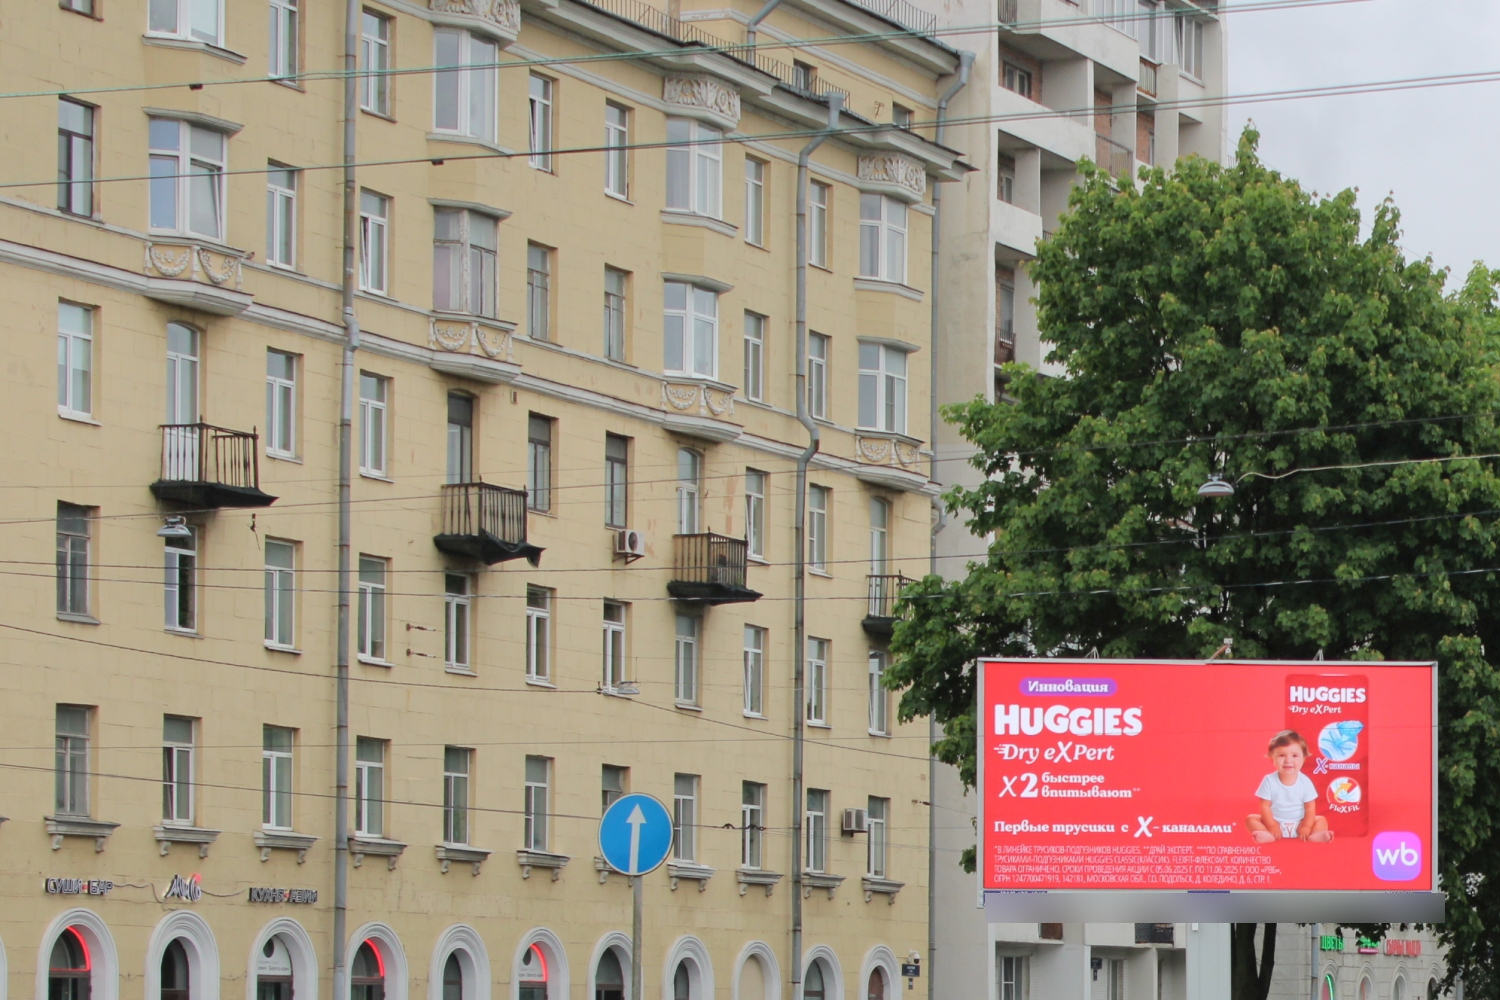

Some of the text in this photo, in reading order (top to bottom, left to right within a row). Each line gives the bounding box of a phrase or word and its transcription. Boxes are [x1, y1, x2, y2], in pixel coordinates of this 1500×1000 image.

[1028, 679, 1109, 693] Инновация
[1290, 686, 1366, 703] HUGGIES
[994, 704, 1143, 736] HUGGIES
[994, 741, 1115, 765] Dry eXPert
[1041, 772, 1105, 786] быстрее
[994, 820, 1050, 834] Первые
[1052, 821, 1115, 833] трусики
[1376, 840, 1419, 866] wb
[46, 878, 113, 896] СУШИ БАР
